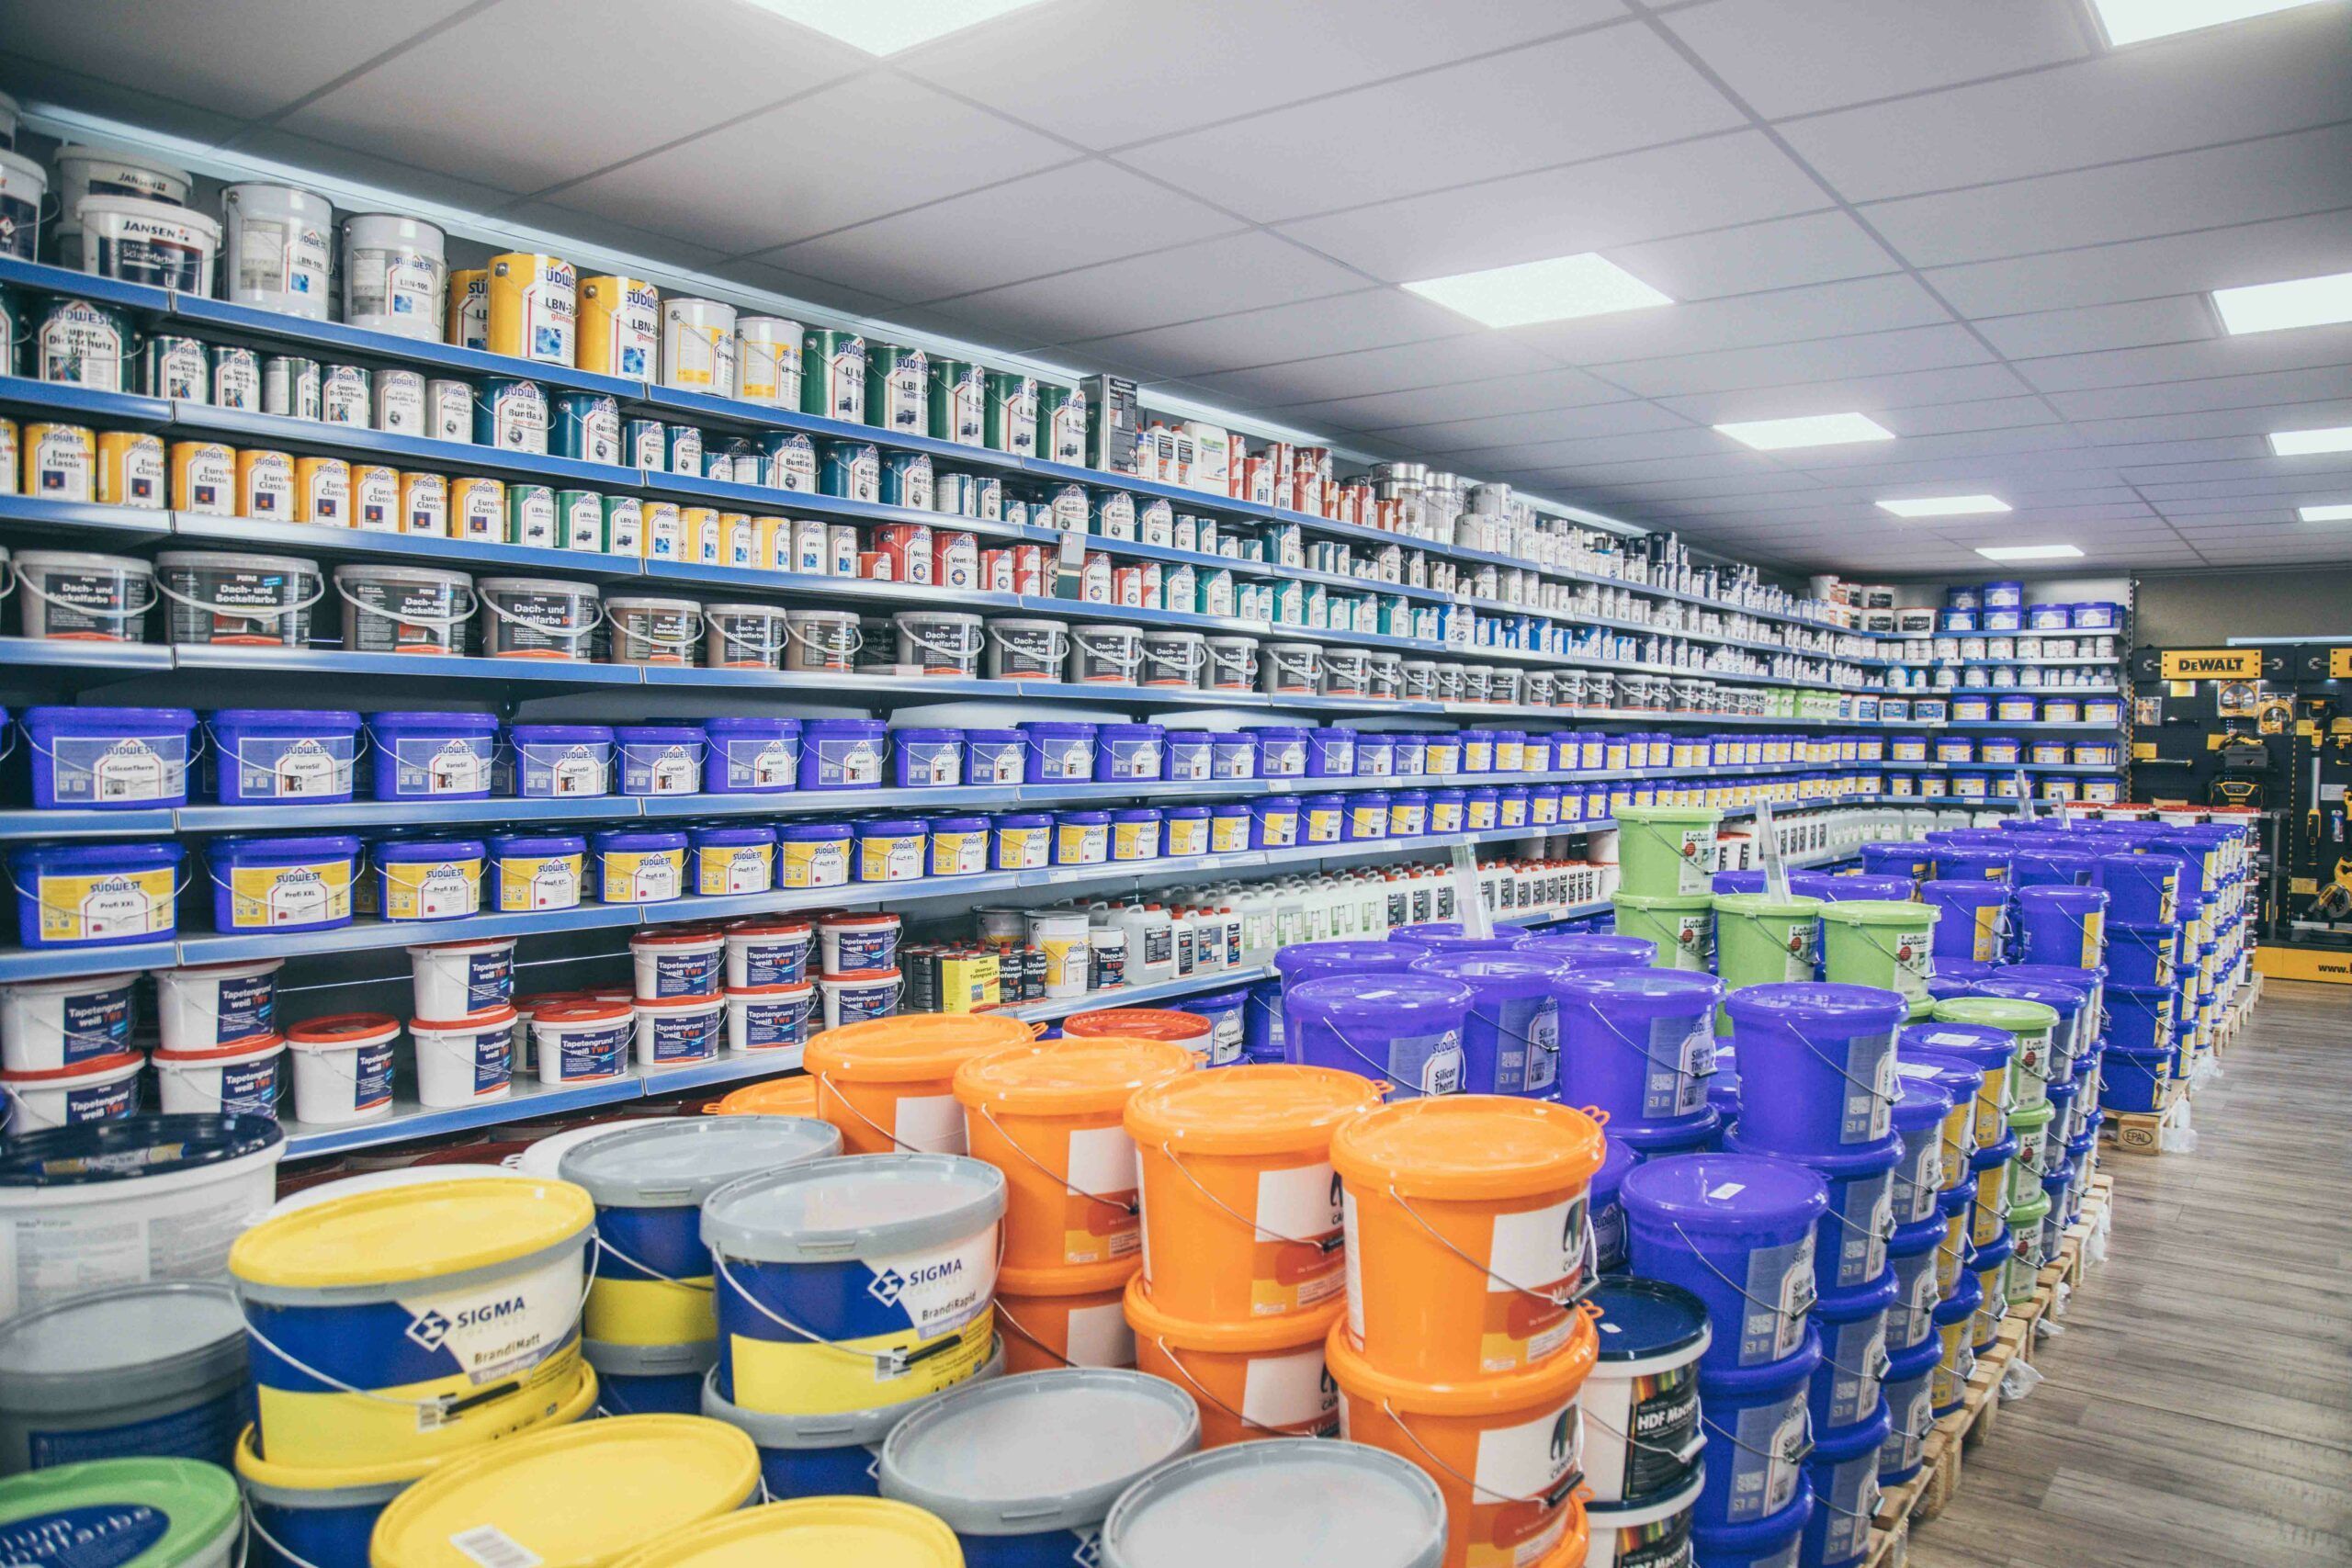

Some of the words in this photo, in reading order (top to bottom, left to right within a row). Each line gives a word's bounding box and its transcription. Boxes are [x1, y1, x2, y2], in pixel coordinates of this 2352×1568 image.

[123, 220, 175, 238] JANSEN
[51, 449, 76, 460] Euro
[47, 458, 82, 469] Classic
[204, 466, 224, 475] Euro
[198, 474, 229, 485] Classic
[264, 474, 284, 482] Euro
[259, 481, 288, 491] Classic
[373, 487, 391, 496] Euro
[368, 495, 394, 504] Classic
[421, 494, 439, 503] Euro
[478, 499, 494, 507] Euro
[416, 502, 442, 512] Classic
[473, 506, 498, 515] Classic
[62, 583, 93, 594] Dach-
[96, 586, 113, 594] und
[220, 585, 251, 595] Dach-
[254, 585, 273, 595] und
[401, 605, 448, 615] Sockelfarb
[514, 604, 545, 614] Dach-
[548, 604, 565, 615] und
[501, 614, 560, 626] Sokelfarbe
[915, 640, 959, 649] Skelfarbe
[105, 744, 155, 756] SÜDWEST
[285, 745, 328, 755] SÜDWEST
[437, 746, 473, 754] SÜDWEST
[561, 750, 595, 760] SÜDWEST
[660, 750, 690, 759] SÜDWEST
[107, 764, 154, 773] SiliconTherm
[814, 845, 842, 855] SÜDWEST
[891, 840, 917, 850] SÜDWEST
[639, 855, 672, 867] SÜDWEST
[733, 851, 763, 861] SÜDWEST
[426, 867, 465, 878] SÜDWEST
[538, 863, 571, 873] SÜDWEST
[277, 872, 322, 884] SÜDWEST
[90, 880, 142, 894] SÜDWEST
[285, 890, 302, 898] Profi
[841, 938, 883, 947] Tapetengrund
[749, 950, 794, 962] Tapetengrund
[659, 960, 706, 971] Tapetengrund
[841, 994, 883, 1004] Tapetengrund
[749, 1009, 795, 1021] Tapetengrund
[656, 1021, 704, 1033] Tapetengrund
[662, 1032, 681, 1040] weiß
[562, 1037, 613, 1049] Tapetengrund
[570, 1048, 589, 1056] weiß
[1435, 1067, 1456, 1082] Silicon
[1434, 1079, 1454, 1094] Therm
[910, 1258, 963, 1286] SIGMA
[922, 1291, 977, 1321] BrandiRapid
[457, 1296, 526, 1328] SIGMA
[474, 1333, 540, 1365] BrandiMatt
[1637, 1411, 1666, 1431] HDF
